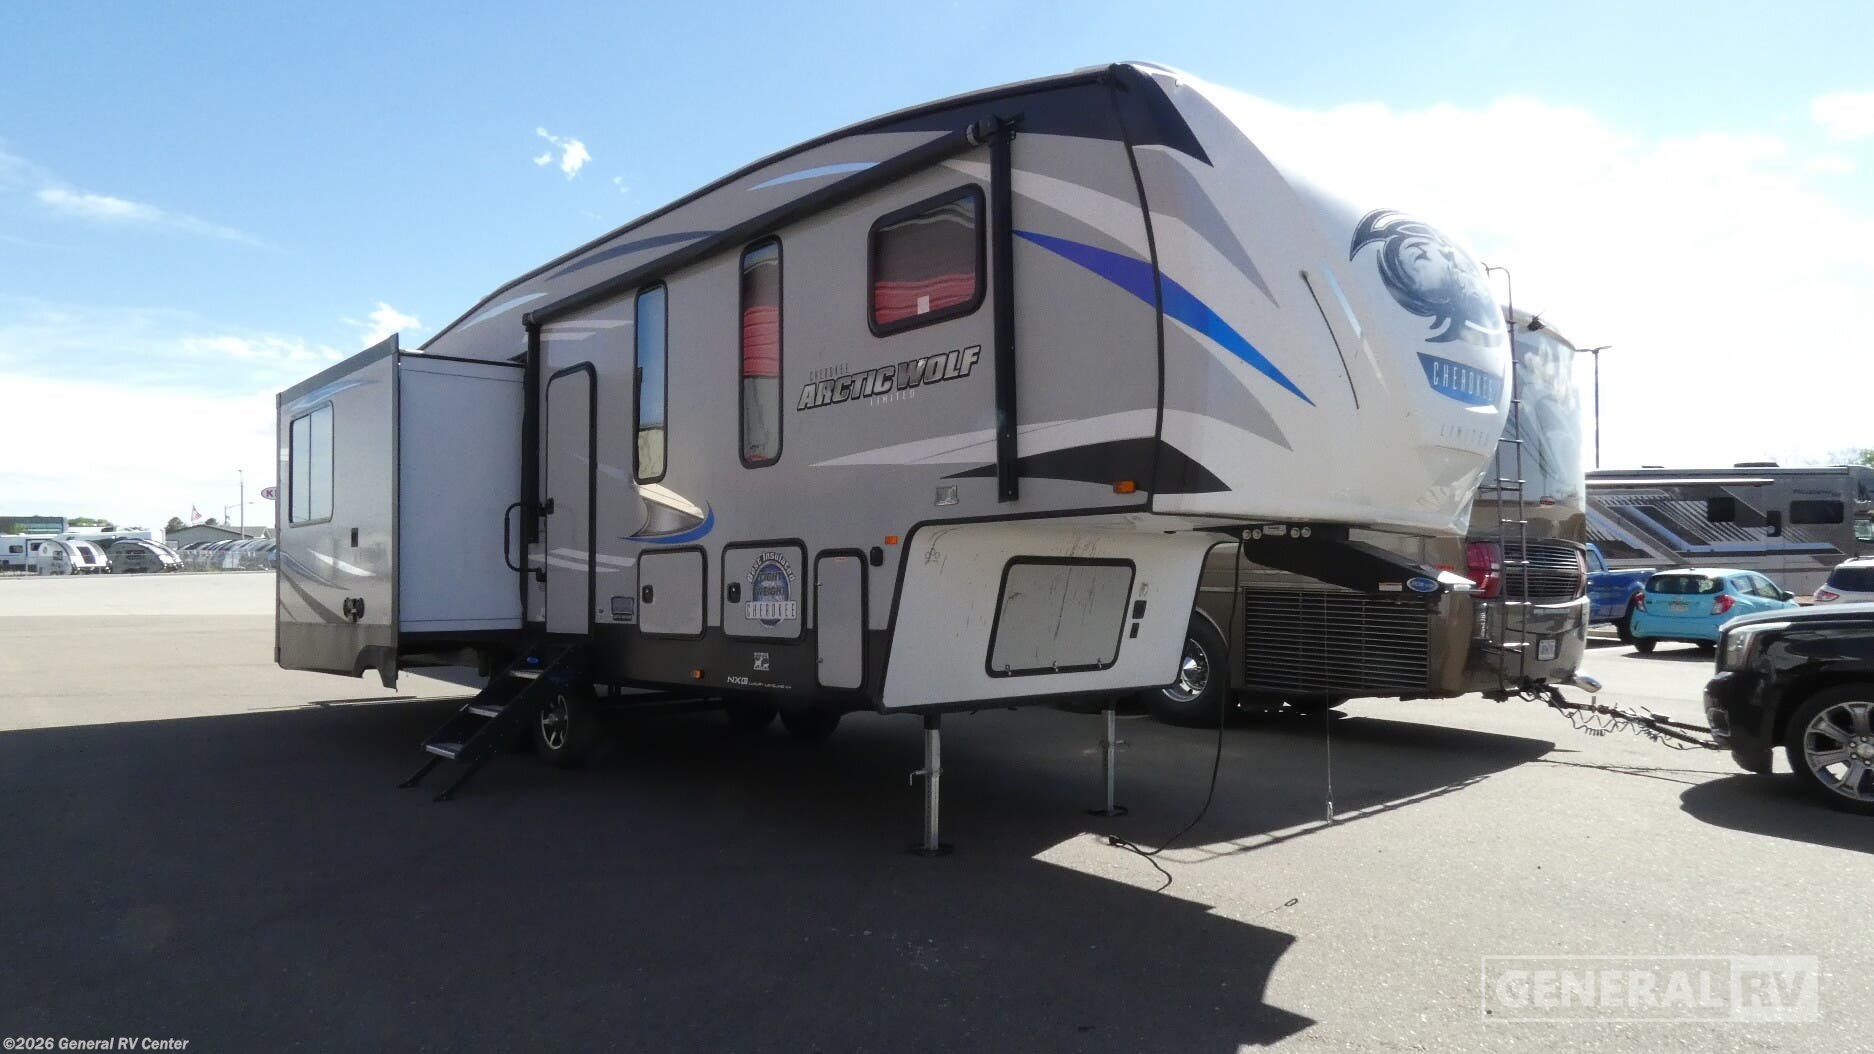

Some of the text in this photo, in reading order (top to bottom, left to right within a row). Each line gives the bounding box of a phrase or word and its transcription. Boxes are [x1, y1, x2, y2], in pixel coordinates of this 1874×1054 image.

[797, 344, 981, 411] ARCTIC WOLF
[870, 389, 915, 407] LIMITED
[762, 551, 796, 583] Insulated
[746, 602, 795, 618] CHEROKEE
